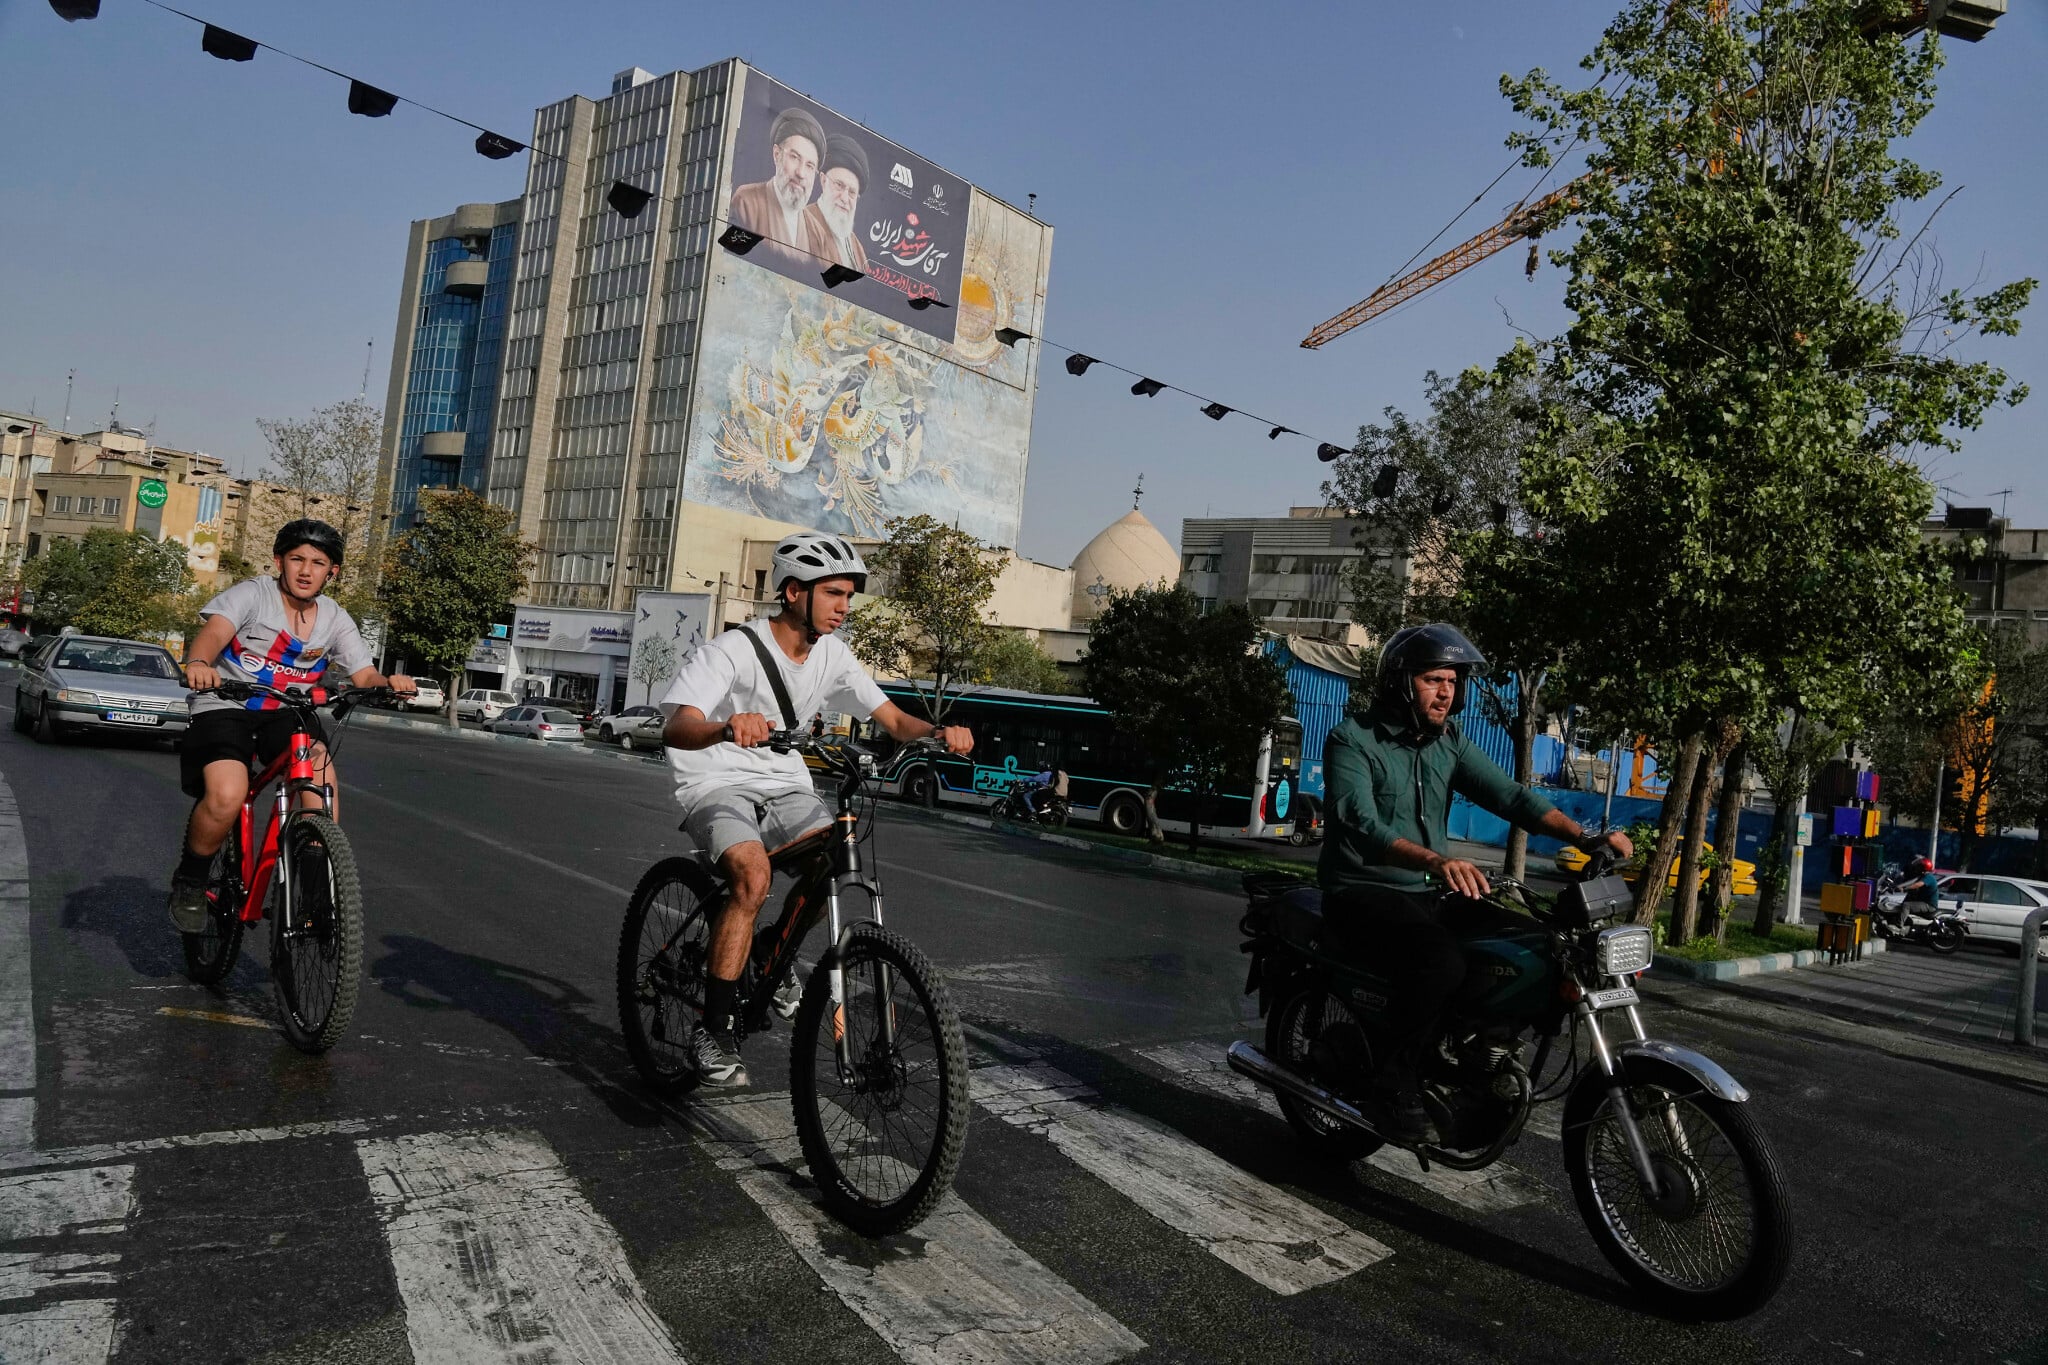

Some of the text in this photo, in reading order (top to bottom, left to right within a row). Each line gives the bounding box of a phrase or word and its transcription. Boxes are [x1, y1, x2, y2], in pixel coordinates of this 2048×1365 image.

[869, 219, 950, 276] آقای شهید ایران
[1599, 990, 1634, 1001] HONDA
